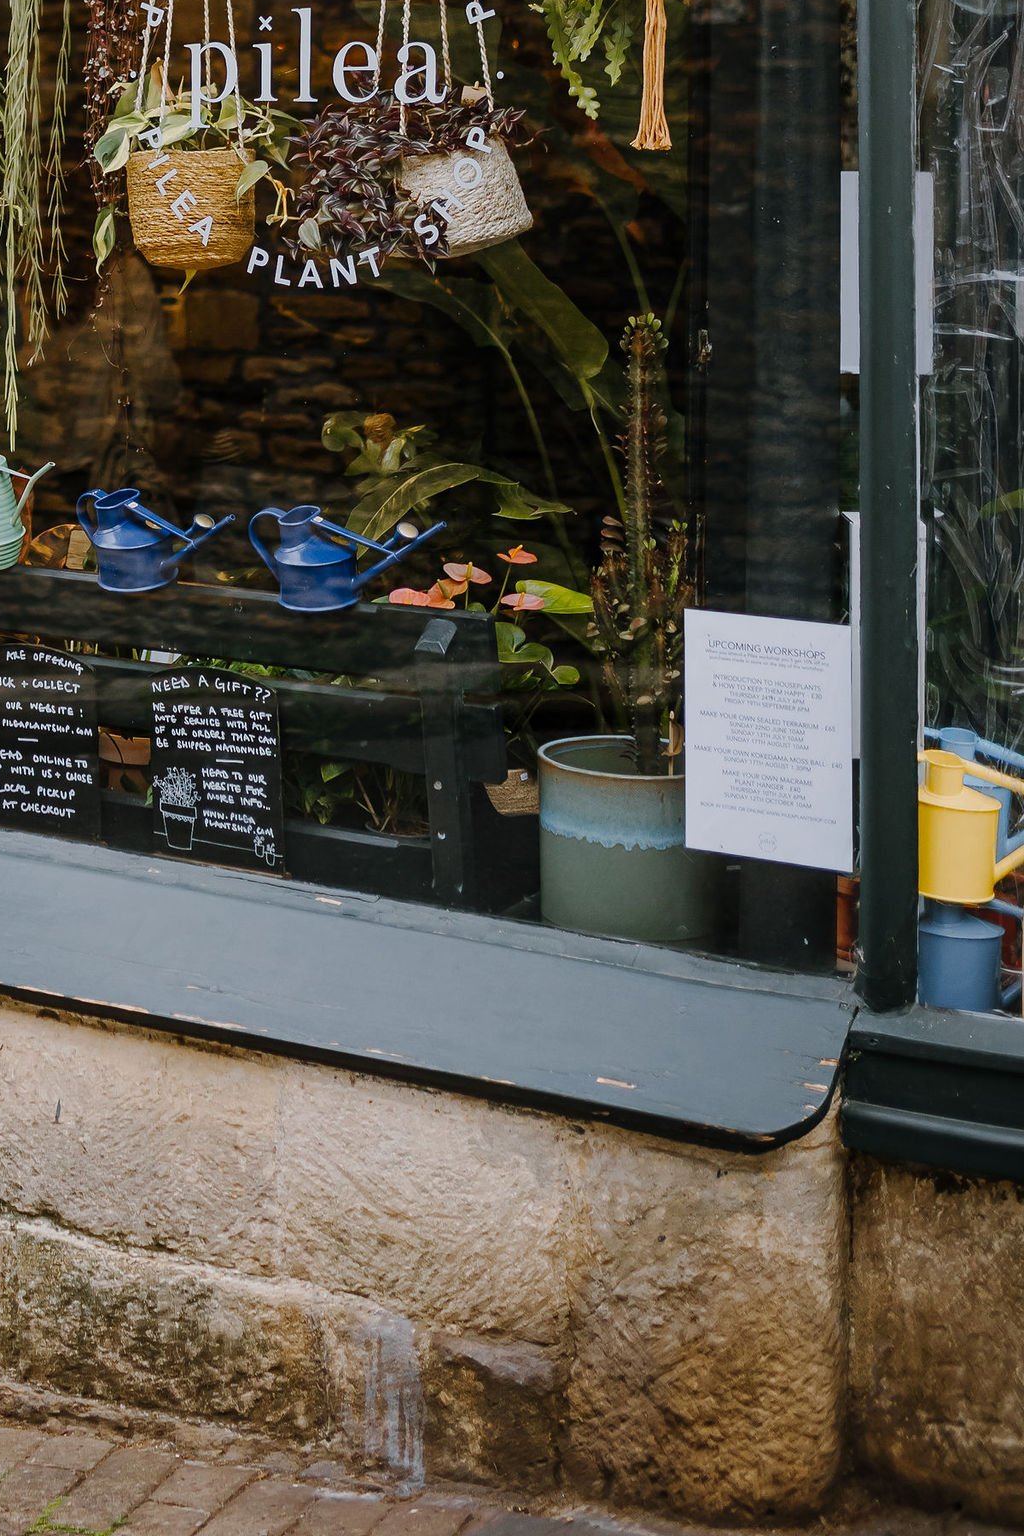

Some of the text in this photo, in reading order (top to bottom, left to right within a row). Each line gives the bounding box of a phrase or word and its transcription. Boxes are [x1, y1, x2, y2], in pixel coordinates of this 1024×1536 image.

[184, 8, 447, 128] pilea
[138, 127, 492, 289] PILEA PLANT SHOP
[708, 639, 826, 661] UPCOMING WORKSHOPS
[6, 650, 26, 661] ARE
[33, 652, 84, 676] OFFERING
[32, 678, 81, 694] COLLECT
[151, 676, 190, 693] NEED
[198, 674, 209, 688] A
[713, 674, 762, 685] INTRODUCTION
[729, 690, 760, 699] THURSDAY
[784, 690, 805, 698] HAPPY
[6, 701, 23, 711] OUR
[152, 702, 273, 722] WE OFFER A FREE GIFT
[725, 697, 744, 705] FRIDAY
[762, 702, 796, 712] SEPTEMBER
[155, 714, 271, 733] NOTE SERVICE WITH ALL
[700, 710, 717, 718] MAKE
[720, 712, 737, 720] YOUR
[739, 714, 755, 722] OWN
[757, 716, 781, 726] SEALED
[783, 720, 819, 730] TERRARIUM
[730, 721, 753, 729] SUNDAY
[155, 725, 277, 746] OF OUR ORDERS THAT CAN
[731, 729, 755, 737] SUNDAY
[156, 736, 169, 748] BE
[177, 739, 211, 752] SHIPPED
[727, 735, 750, 743] SUNDAY
[767, 740, 791, 748] AUGUST
[33, 754, 73, 768] ONLINE
[74, 759, 88, 769] TO
[694, 744, 712, 752] MAKE
[733, 749, 749, 757] OWN
[751, 751, 788, 761] KOKEDAMA
[790, 757, 808, 765] MOSS
[810, 759, 825, 767] BALL
[724, 755, 747, 764] SUNDAY
[765, 761, 789, 769] AUGUST
[10, 766, 35, 777] WITH
[41, 769, 53, 779] US
[201, 767, 268, 786] HEAD TO OUR
[722, 769, 813, 786] MAKE YOUR OWN MACRAME
[202, 780, 268, 798] WEBSITE FOR
[730, 785, 761, 795] THURSDAY
[735, 778, 754, 787] PLANT
[756, 781, 784, 790] HANGER
[37, 786, 75, 800] PICKUP
[207, 792, 235, 804] MORE
[724, 792, 748, 800] SUNDAY
[765, 797, 794, 806] OCTOBER
[2, 799, 76, 819] AT CHECKOUT
